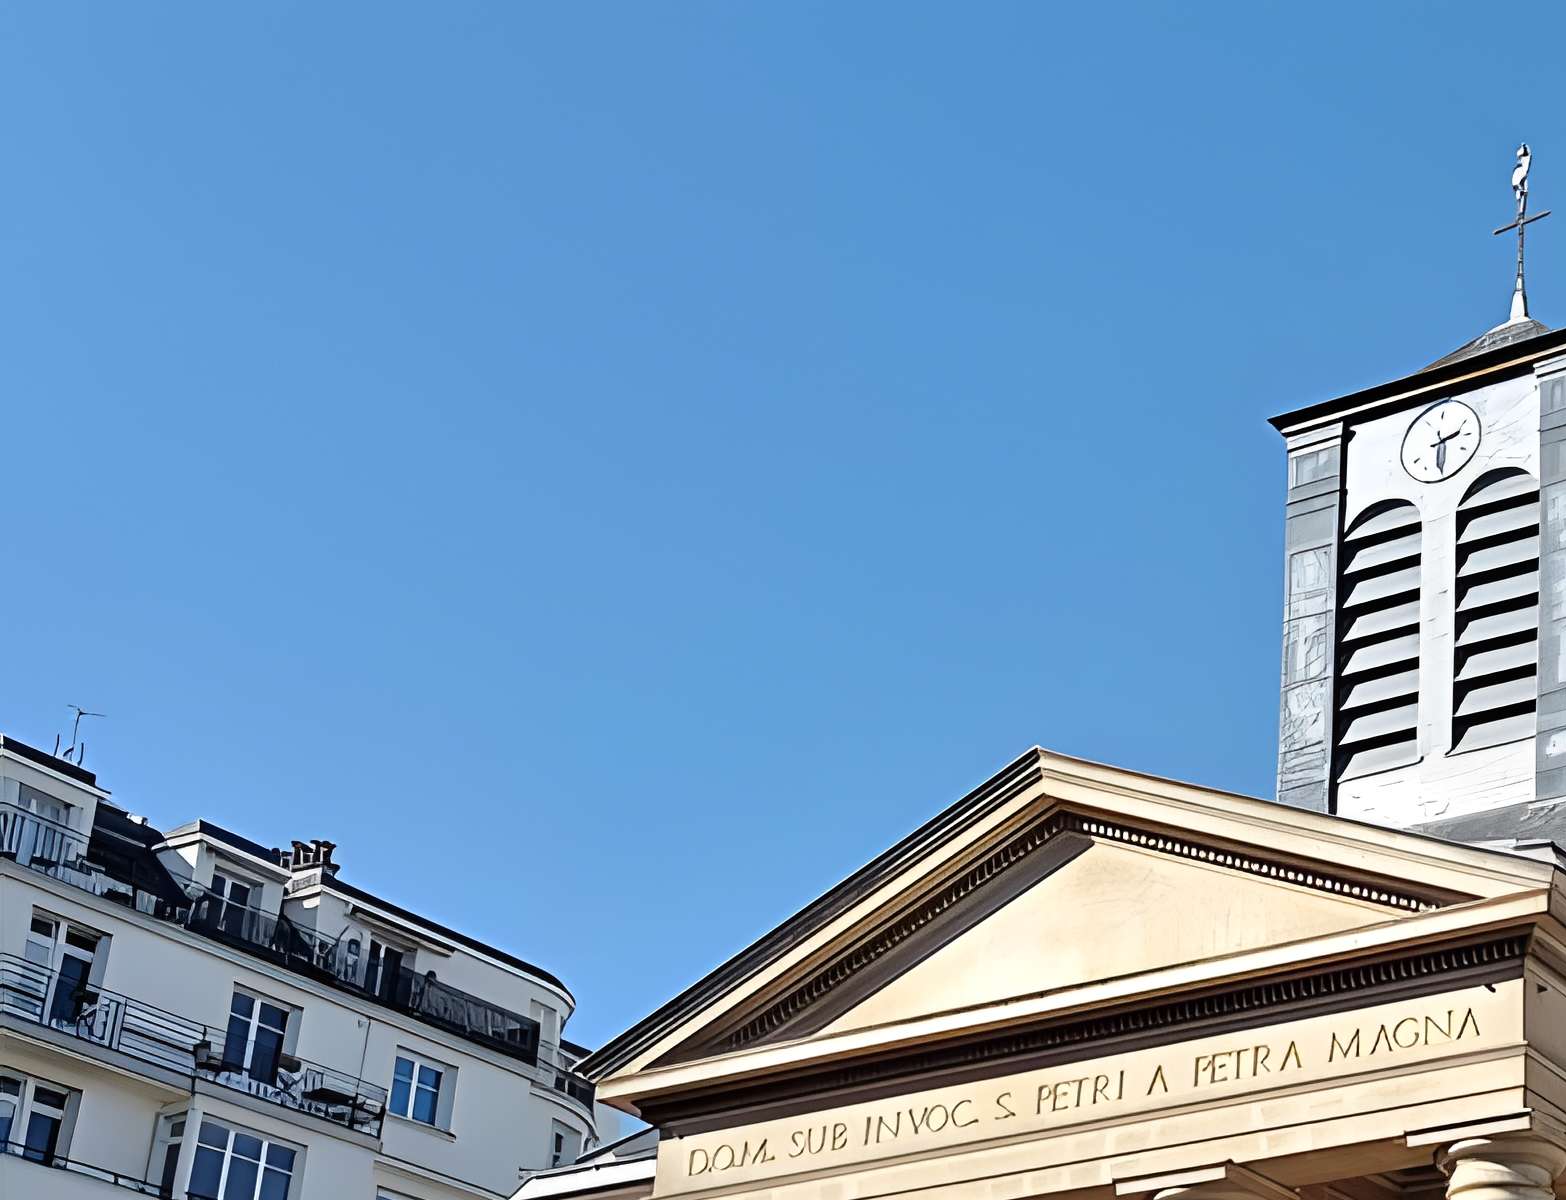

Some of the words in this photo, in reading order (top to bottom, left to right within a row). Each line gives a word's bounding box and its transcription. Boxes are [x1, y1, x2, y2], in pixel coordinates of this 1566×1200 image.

[788, 1122, 848, 1158] SUB
[1036, 1069, 1125, 1115] PETRI
[1146, 1064, 1169, 1096] A
[1193, 1040, 1303, 1088] PETRA
[1328, 1007, 1480, 1063] MAGNA
